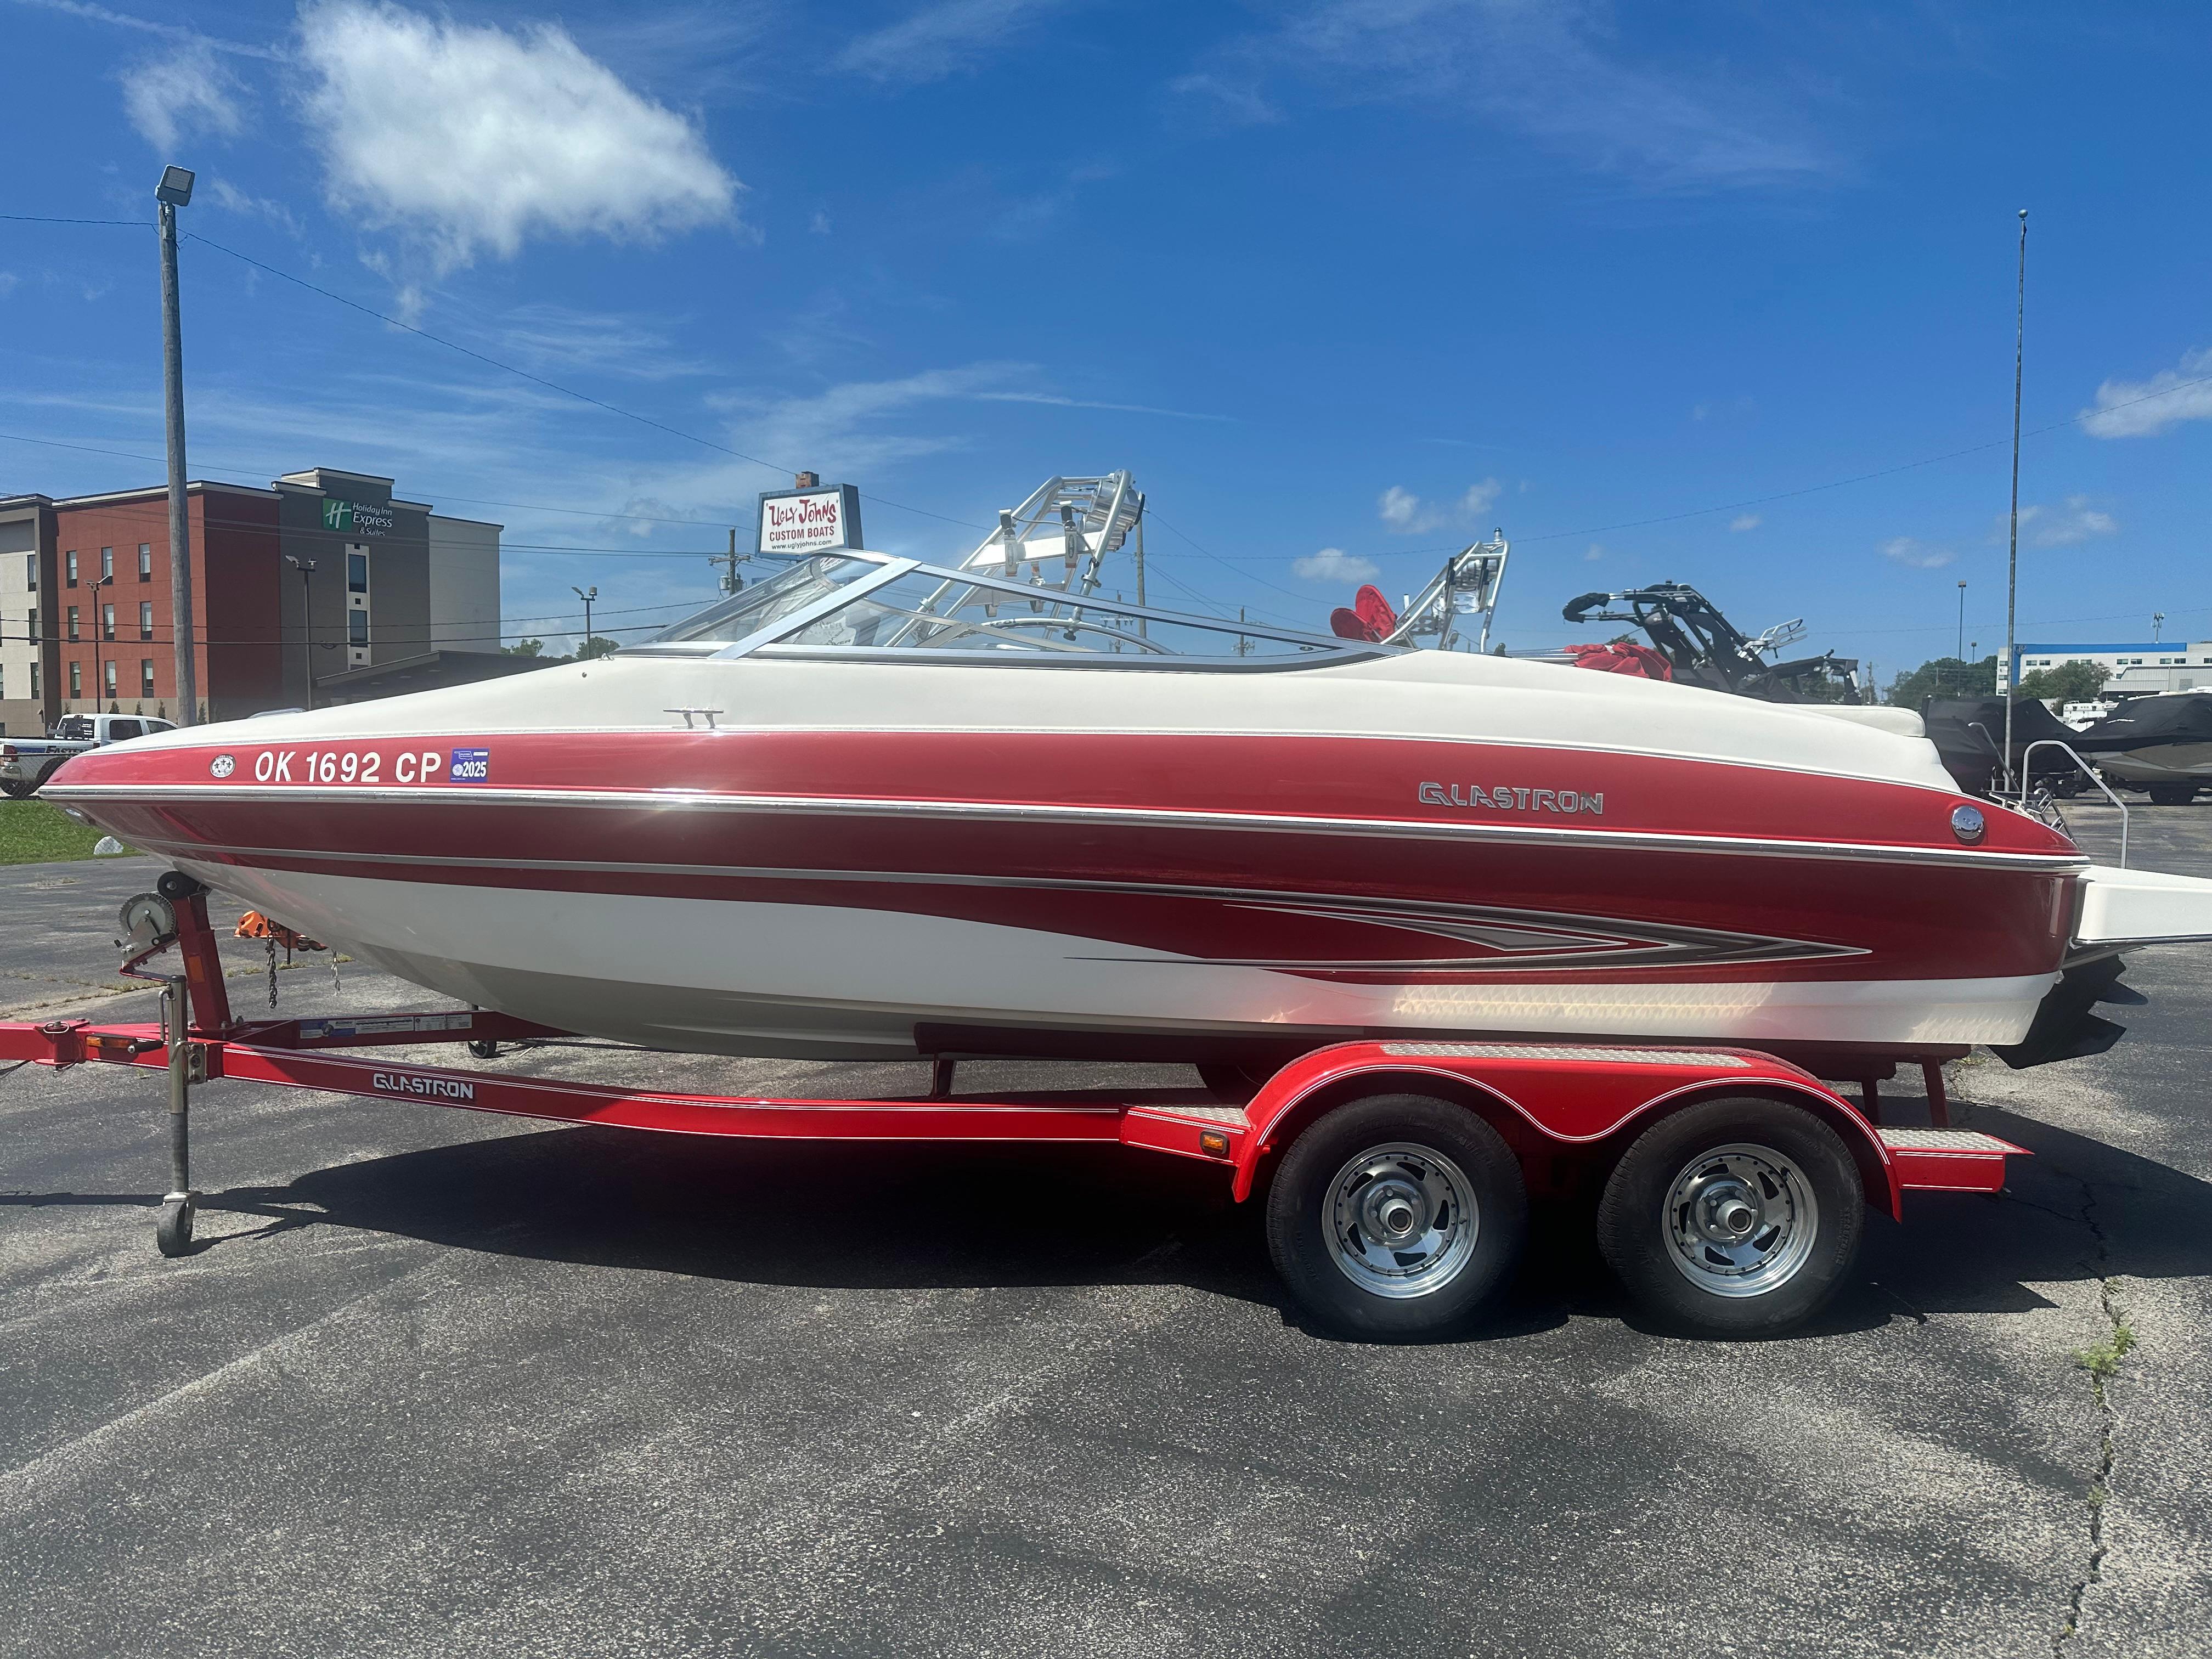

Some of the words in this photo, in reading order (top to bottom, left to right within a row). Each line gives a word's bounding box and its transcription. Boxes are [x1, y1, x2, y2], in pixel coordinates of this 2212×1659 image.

[353, 501, 381, 516] Holiday
[381, 506, 393, 516] Inn
[769, 505, 798, 527] UGLY
[353, 512, 393, 528] Express
[366, 528, 386, 537] Suites
[770, 528, 805, 541] CUSTOM
[808, 526, 834, 538] BOATS
[771, 539, 832, 549] www.uglyjohns.com
[255, 751, 296, 782] OK
[306, 752, 381, 782] 1692
[395, 752, 442, 783] CP
[462, 761, 487, 777] 2025
[1419, 781, 1604, 815] GLASTRON
[373, 1073, 473, 1099] GLASTRON
